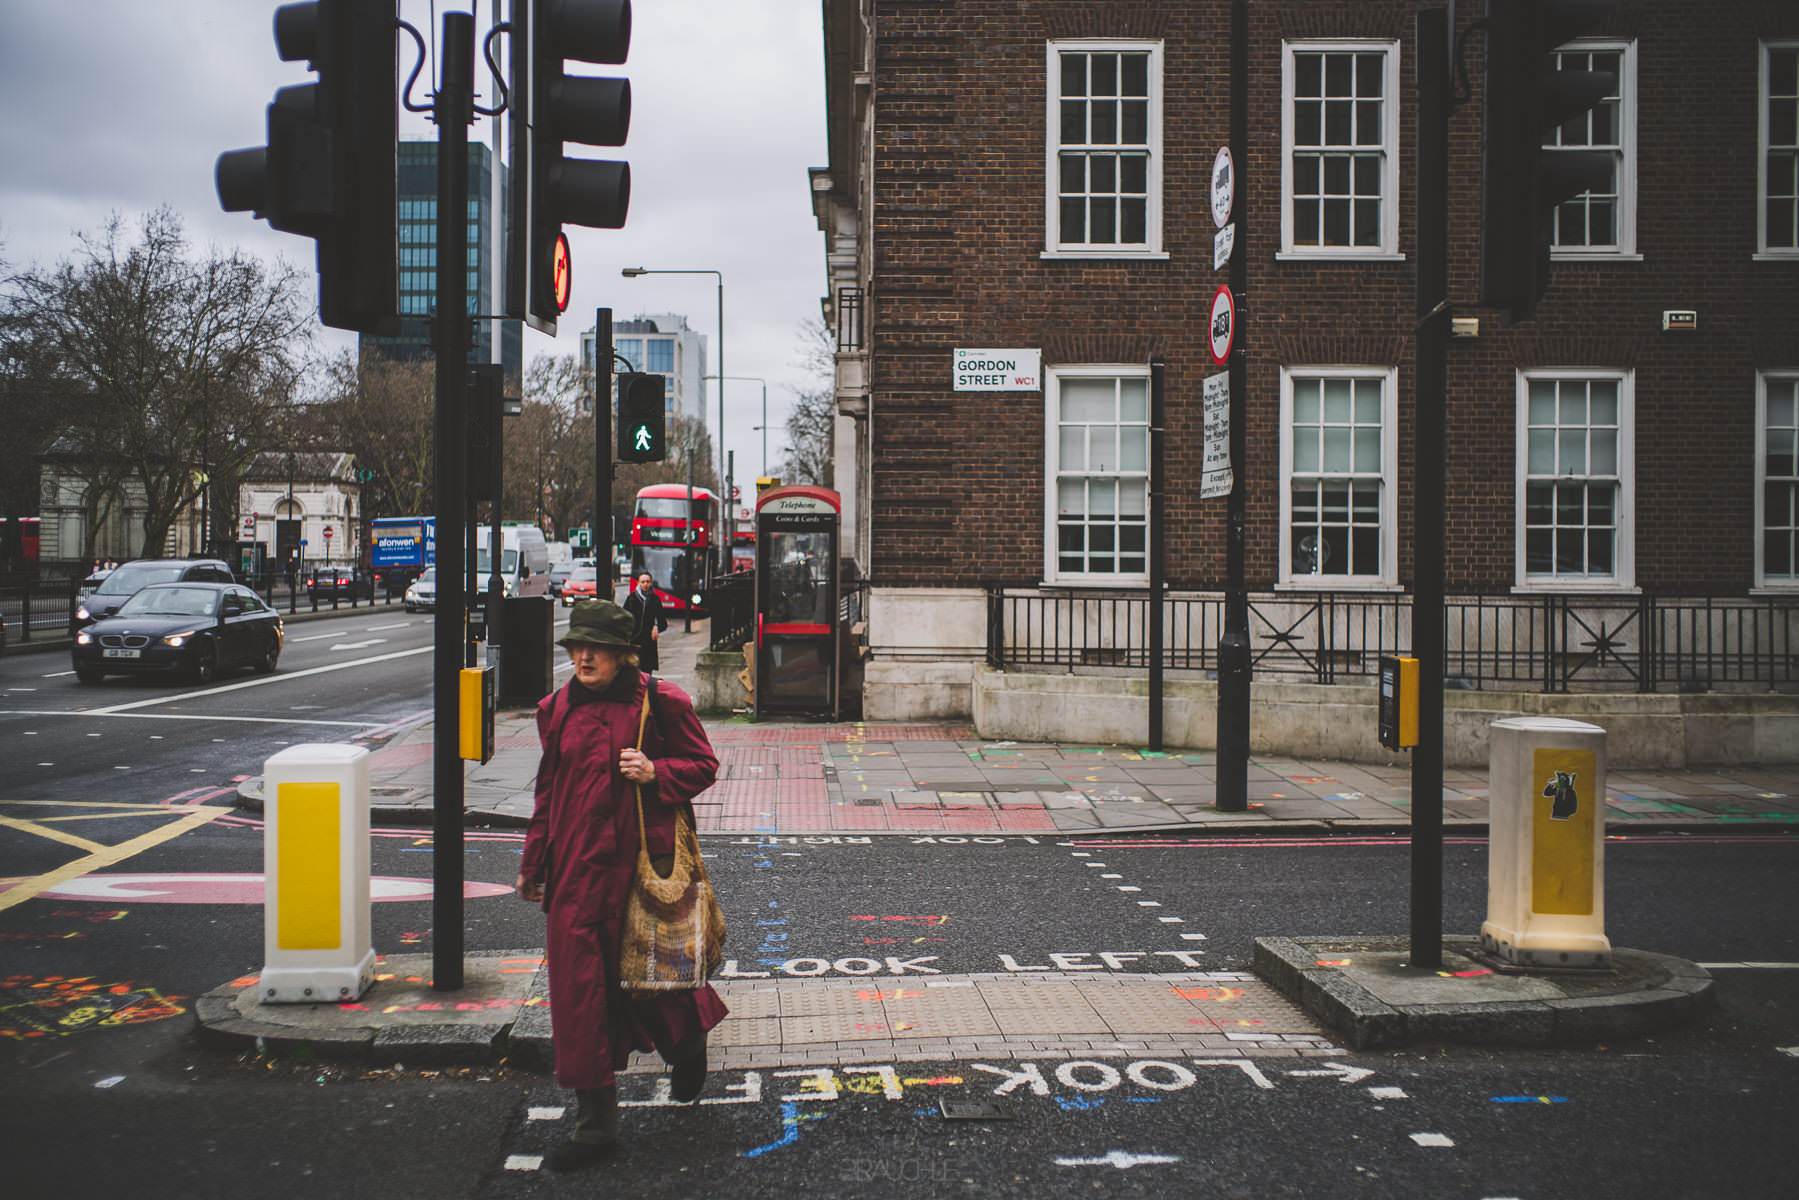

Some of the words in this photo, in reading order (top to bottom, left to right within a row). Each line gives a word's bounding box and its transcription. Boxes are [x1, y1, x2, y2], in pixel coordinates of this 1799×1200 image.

[957, 360, 1016, 371] GORDON
[959, 375, 1007, 385] STREET
[1014, 377, 1035, 385] WC1
[780, 501, 816, 510] Telephone
[730, 836, 873, 844] RIGHT
[912, 836, 1040, 844] LOOK
[719, 955, 942, 978] LOOK
[1000, 951, 1205, 972] LEFT
[971, 1060, 1275, 1096] LOOK
